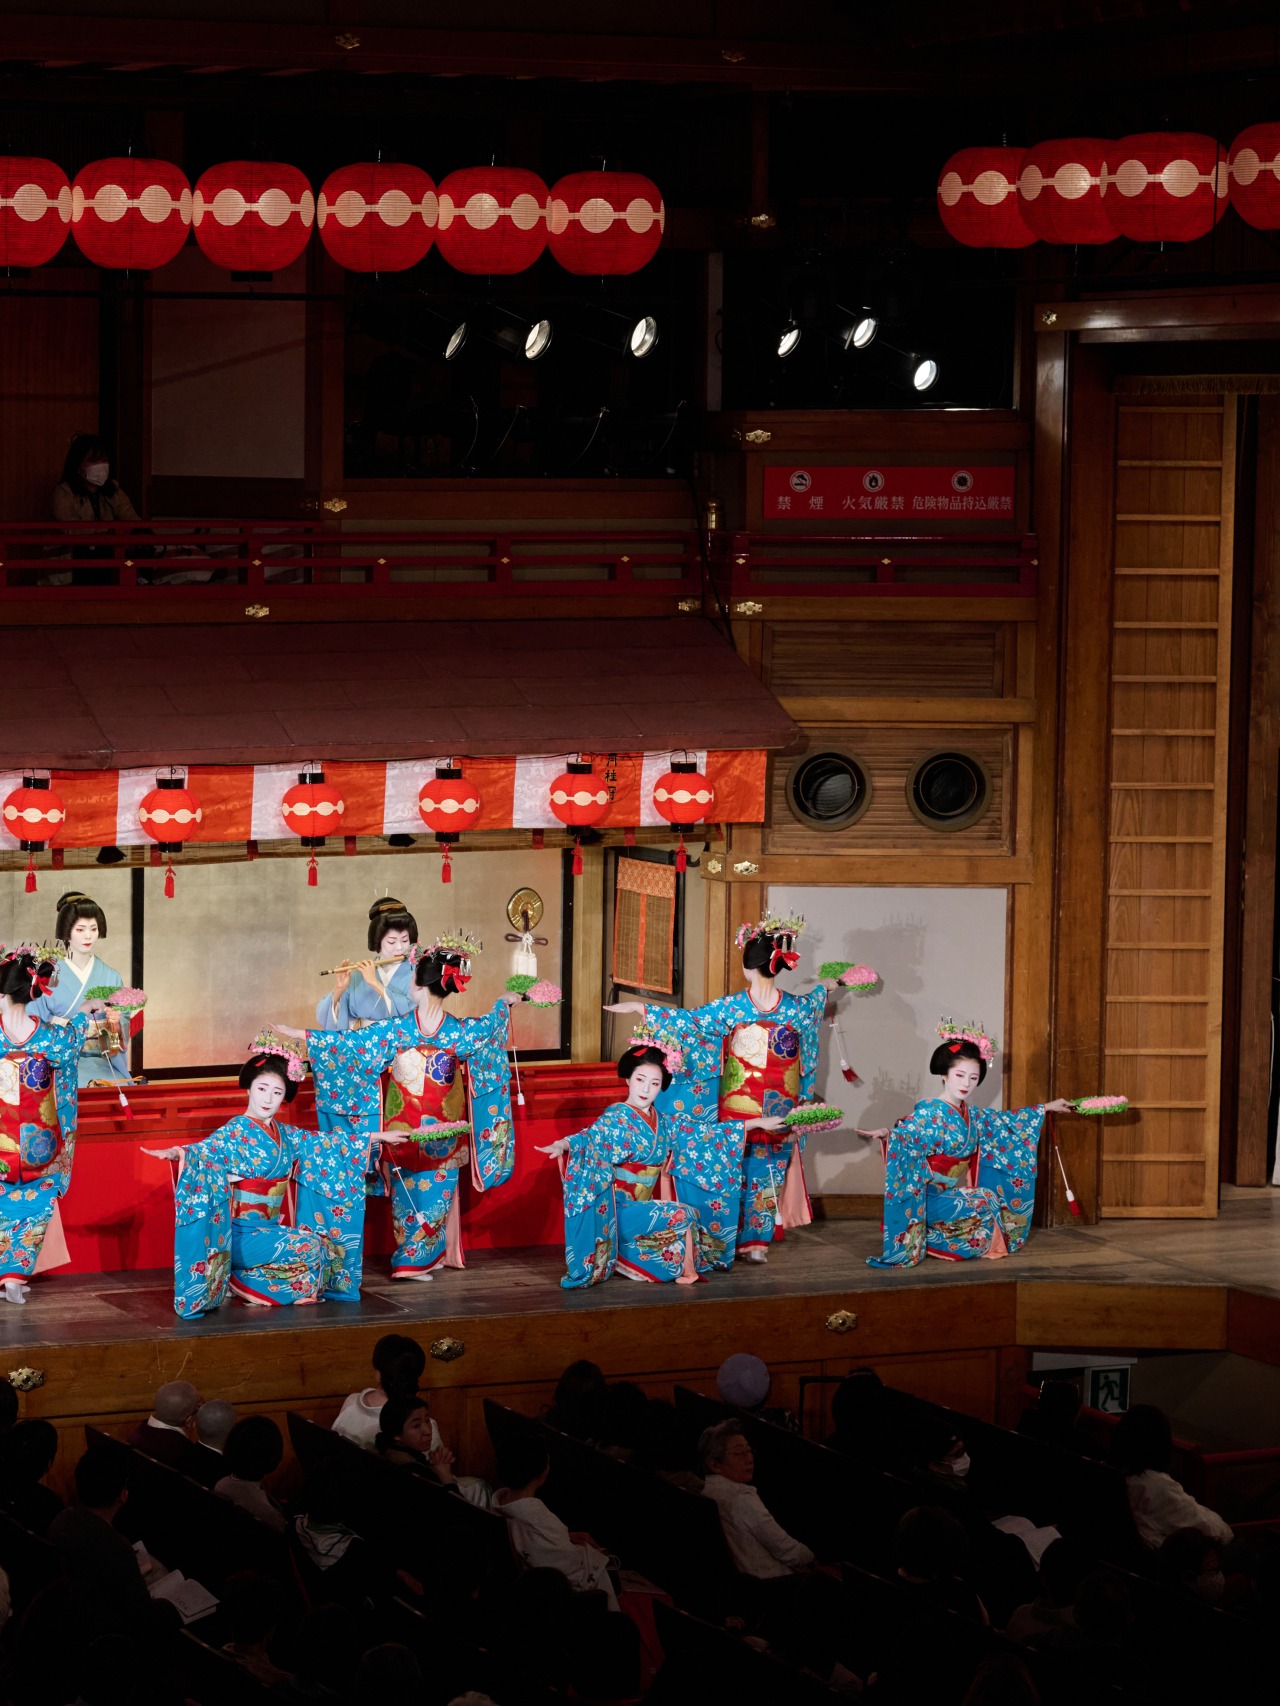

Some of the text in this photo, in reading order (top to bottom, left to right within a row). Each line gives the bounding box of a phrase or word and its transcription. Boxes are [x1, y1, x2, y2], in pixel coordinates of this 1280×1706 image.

[777, 496, 1012, 510] 禁煙 火気厳禁 危険物品持込厳禁
